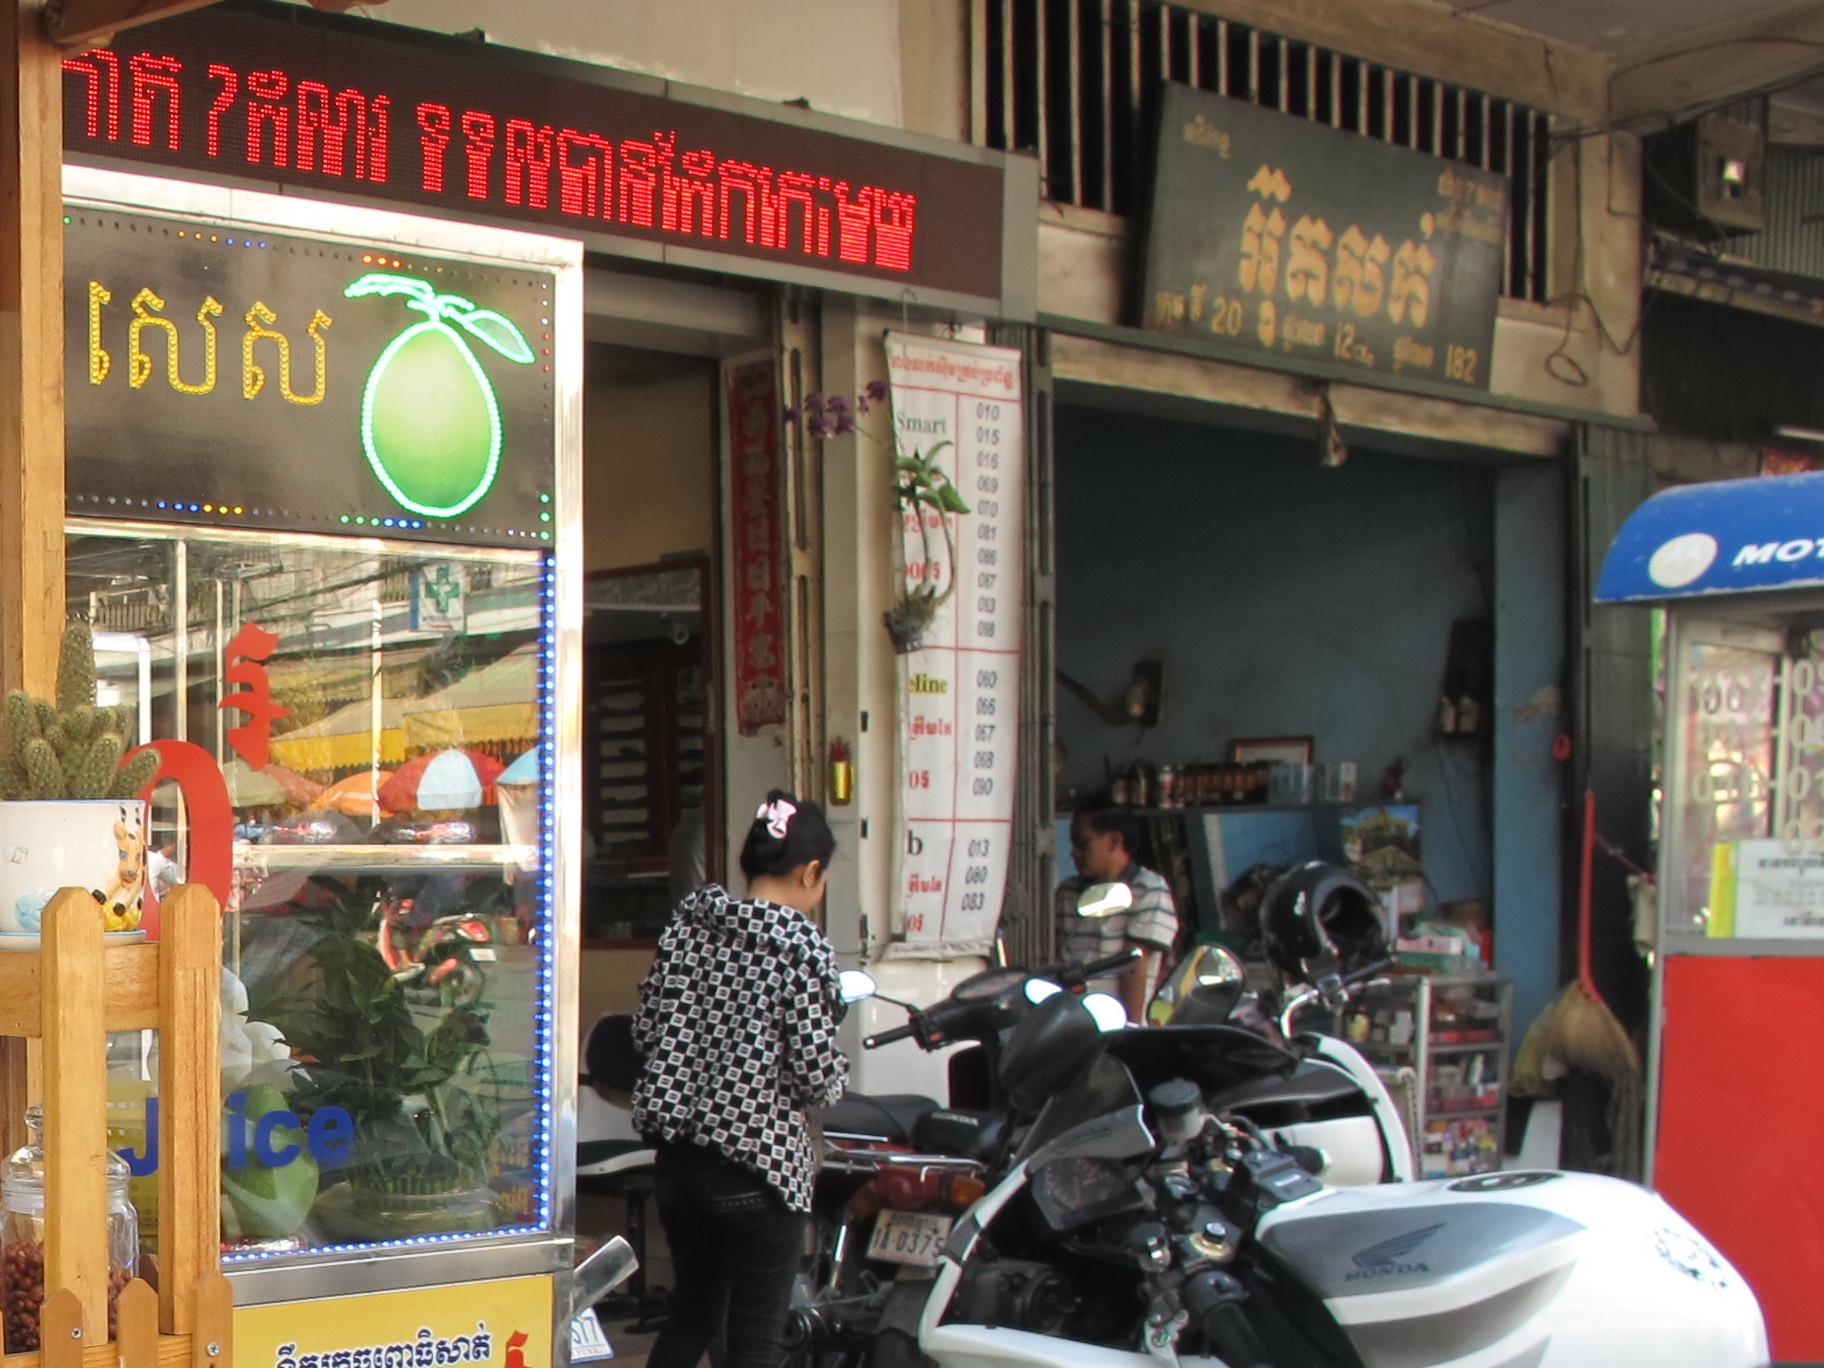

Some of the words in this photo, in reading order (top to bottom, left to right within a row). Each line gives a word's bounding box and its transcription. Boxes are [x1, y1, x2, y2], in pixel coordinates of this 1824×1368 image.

[897, 412, 948, 435] Smart
[977, 427, 1000, 445] 015
[977, 451, 999, 469] 016
[116, 1091, 355, 1177] Jice
[1345, 1262, 1430, 1282] HONDA
